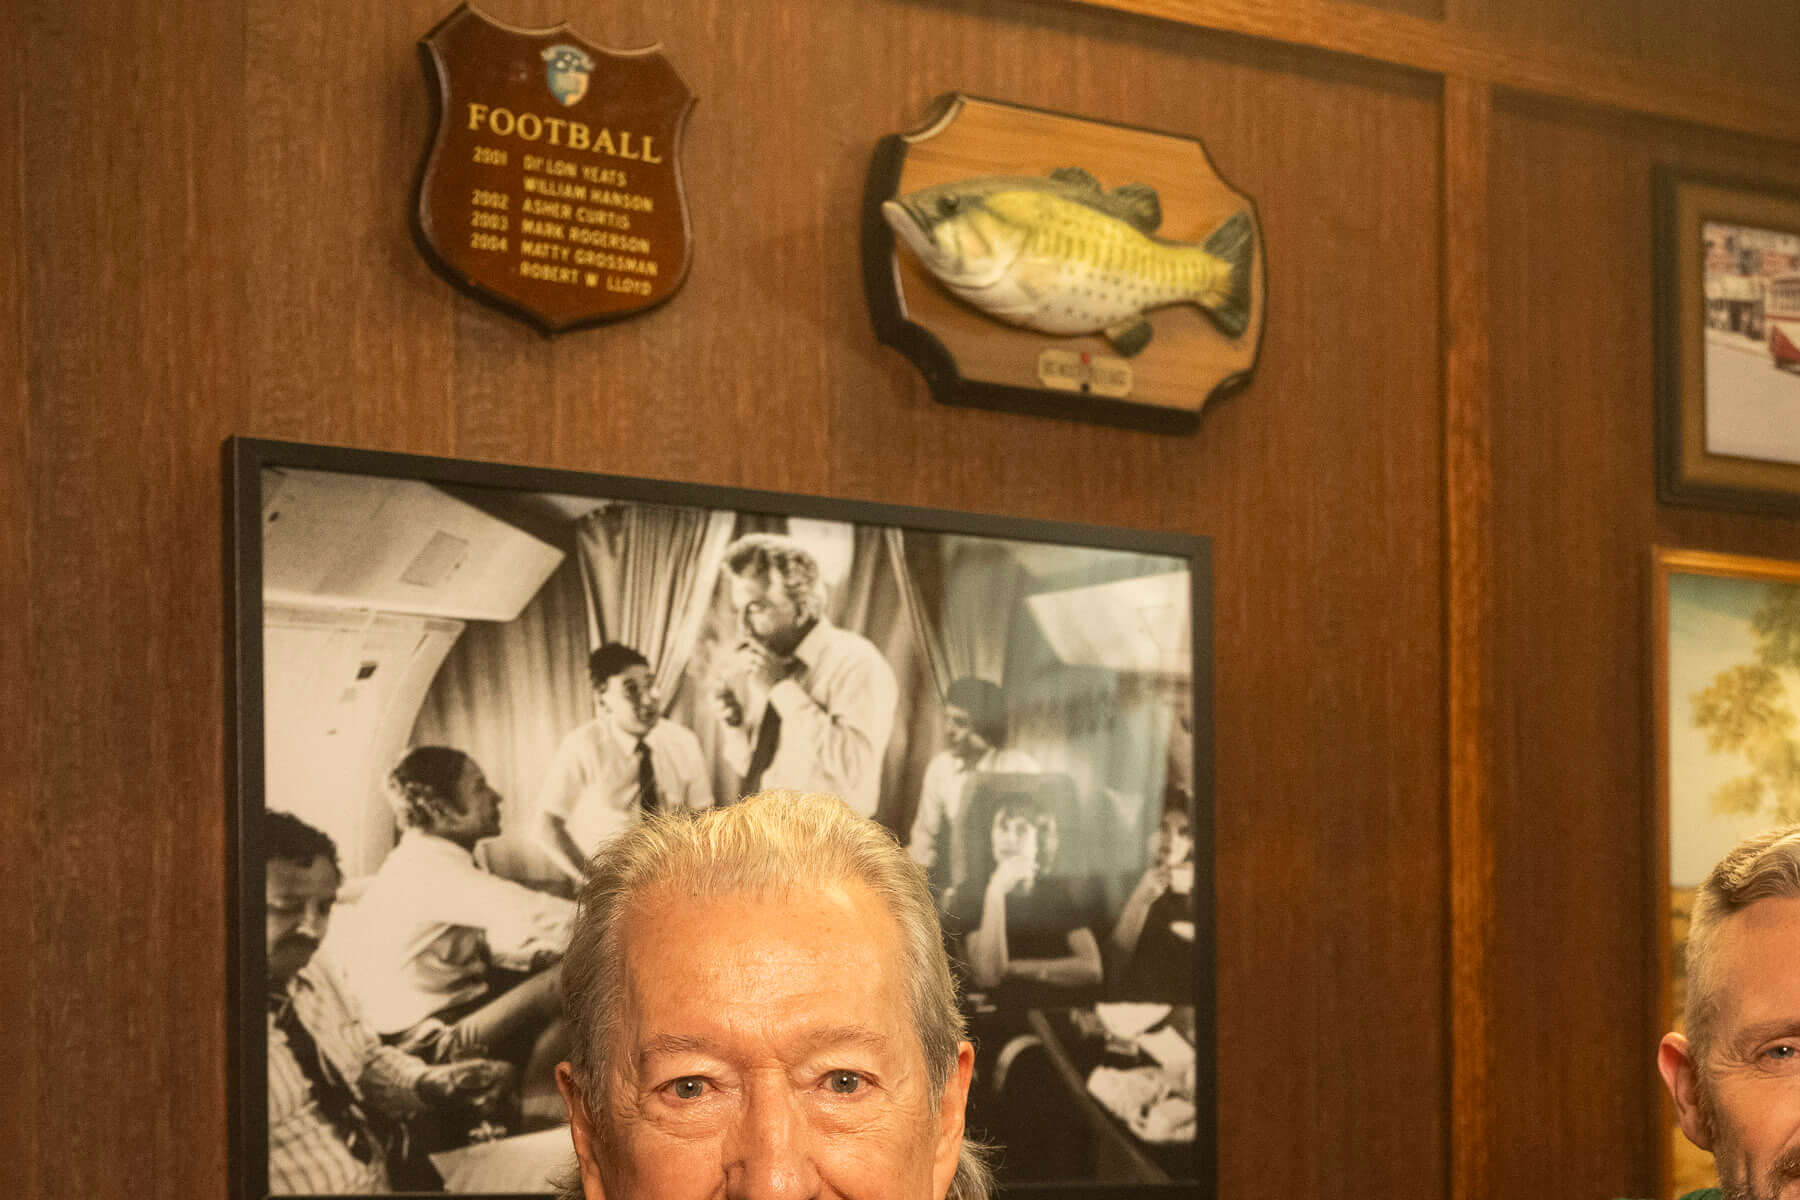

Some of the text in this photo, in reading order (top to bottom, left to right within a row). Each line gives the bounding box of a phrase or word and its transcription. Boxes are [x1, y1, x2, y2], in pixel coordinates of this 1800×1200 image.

[468, 103, 662, 164] FOOTBALL
[523, 176, 587, 200] WILLIAM
[471, 190, 509, 210] 2002
[521, 219, 565, 240] MARK
[520, 261, 579, 283] ROBERT
